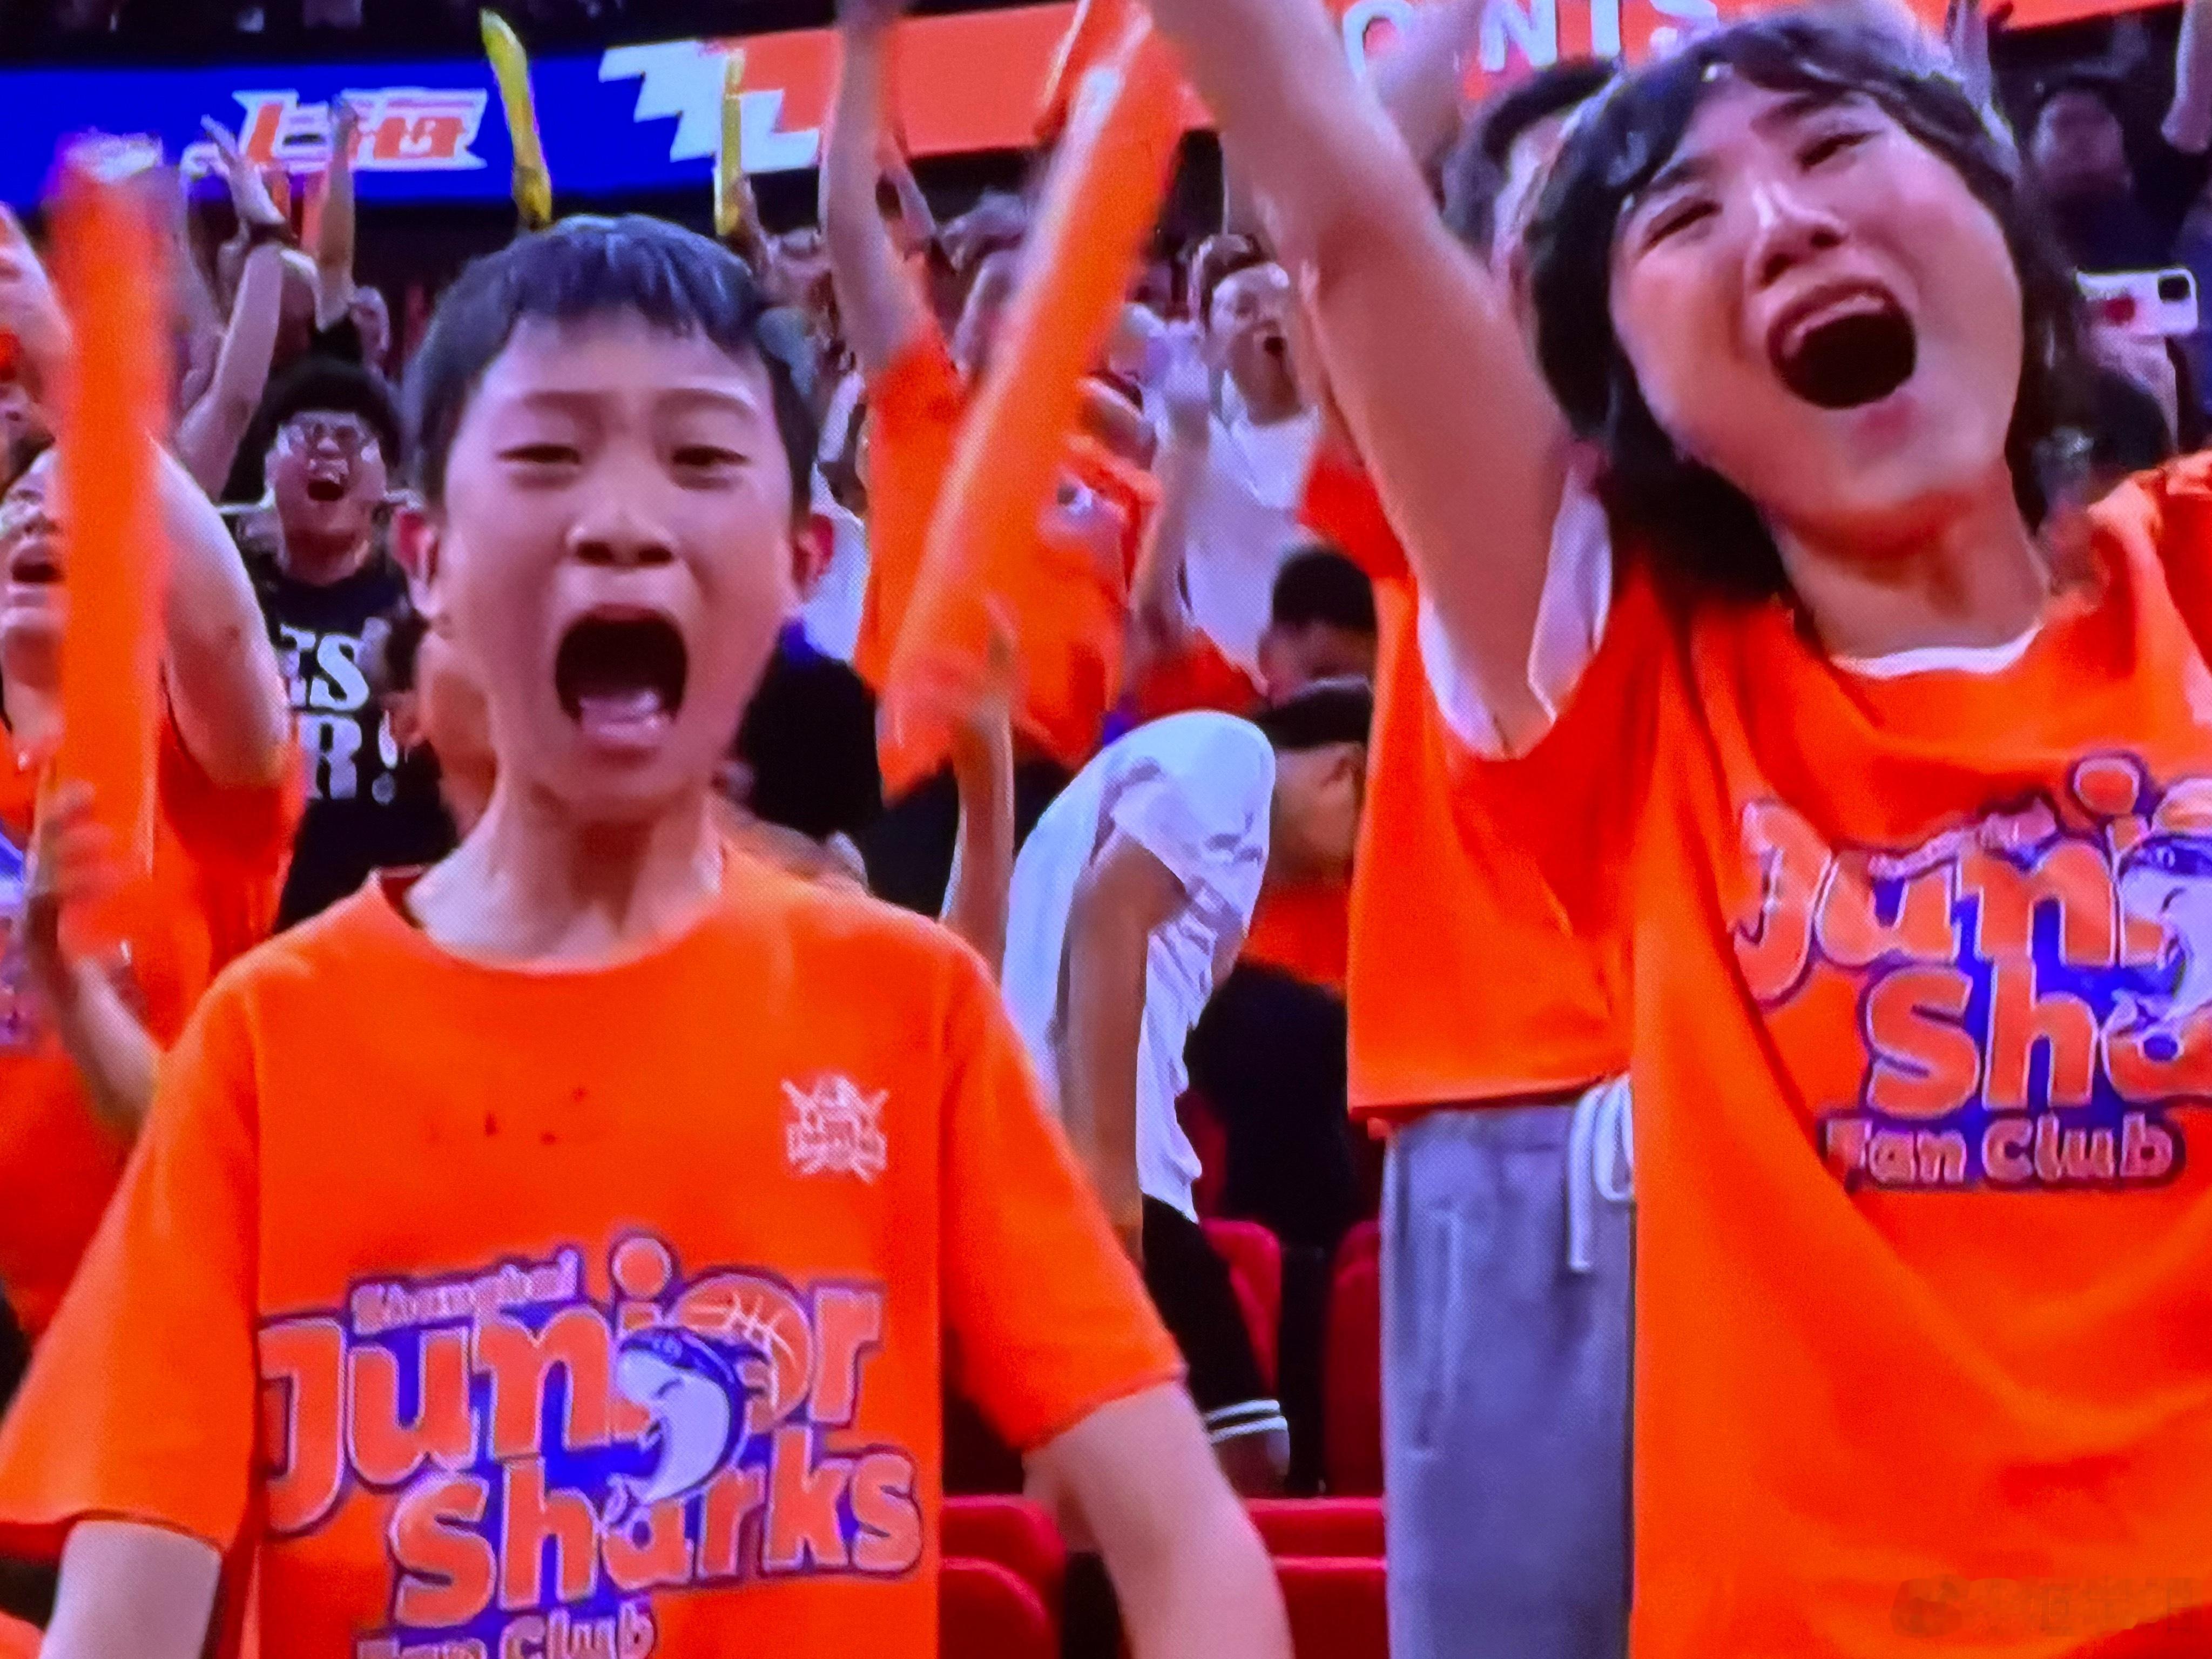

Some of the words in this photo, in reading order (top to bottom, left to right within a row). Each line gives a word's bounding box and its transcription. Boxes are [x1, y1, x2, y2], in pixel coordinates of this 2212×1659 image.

[1982, 1112, 2173, 1182] Club
[258, 1237, 882, 1533] Junior
[389, 1426, 922, 1628] Sharks
